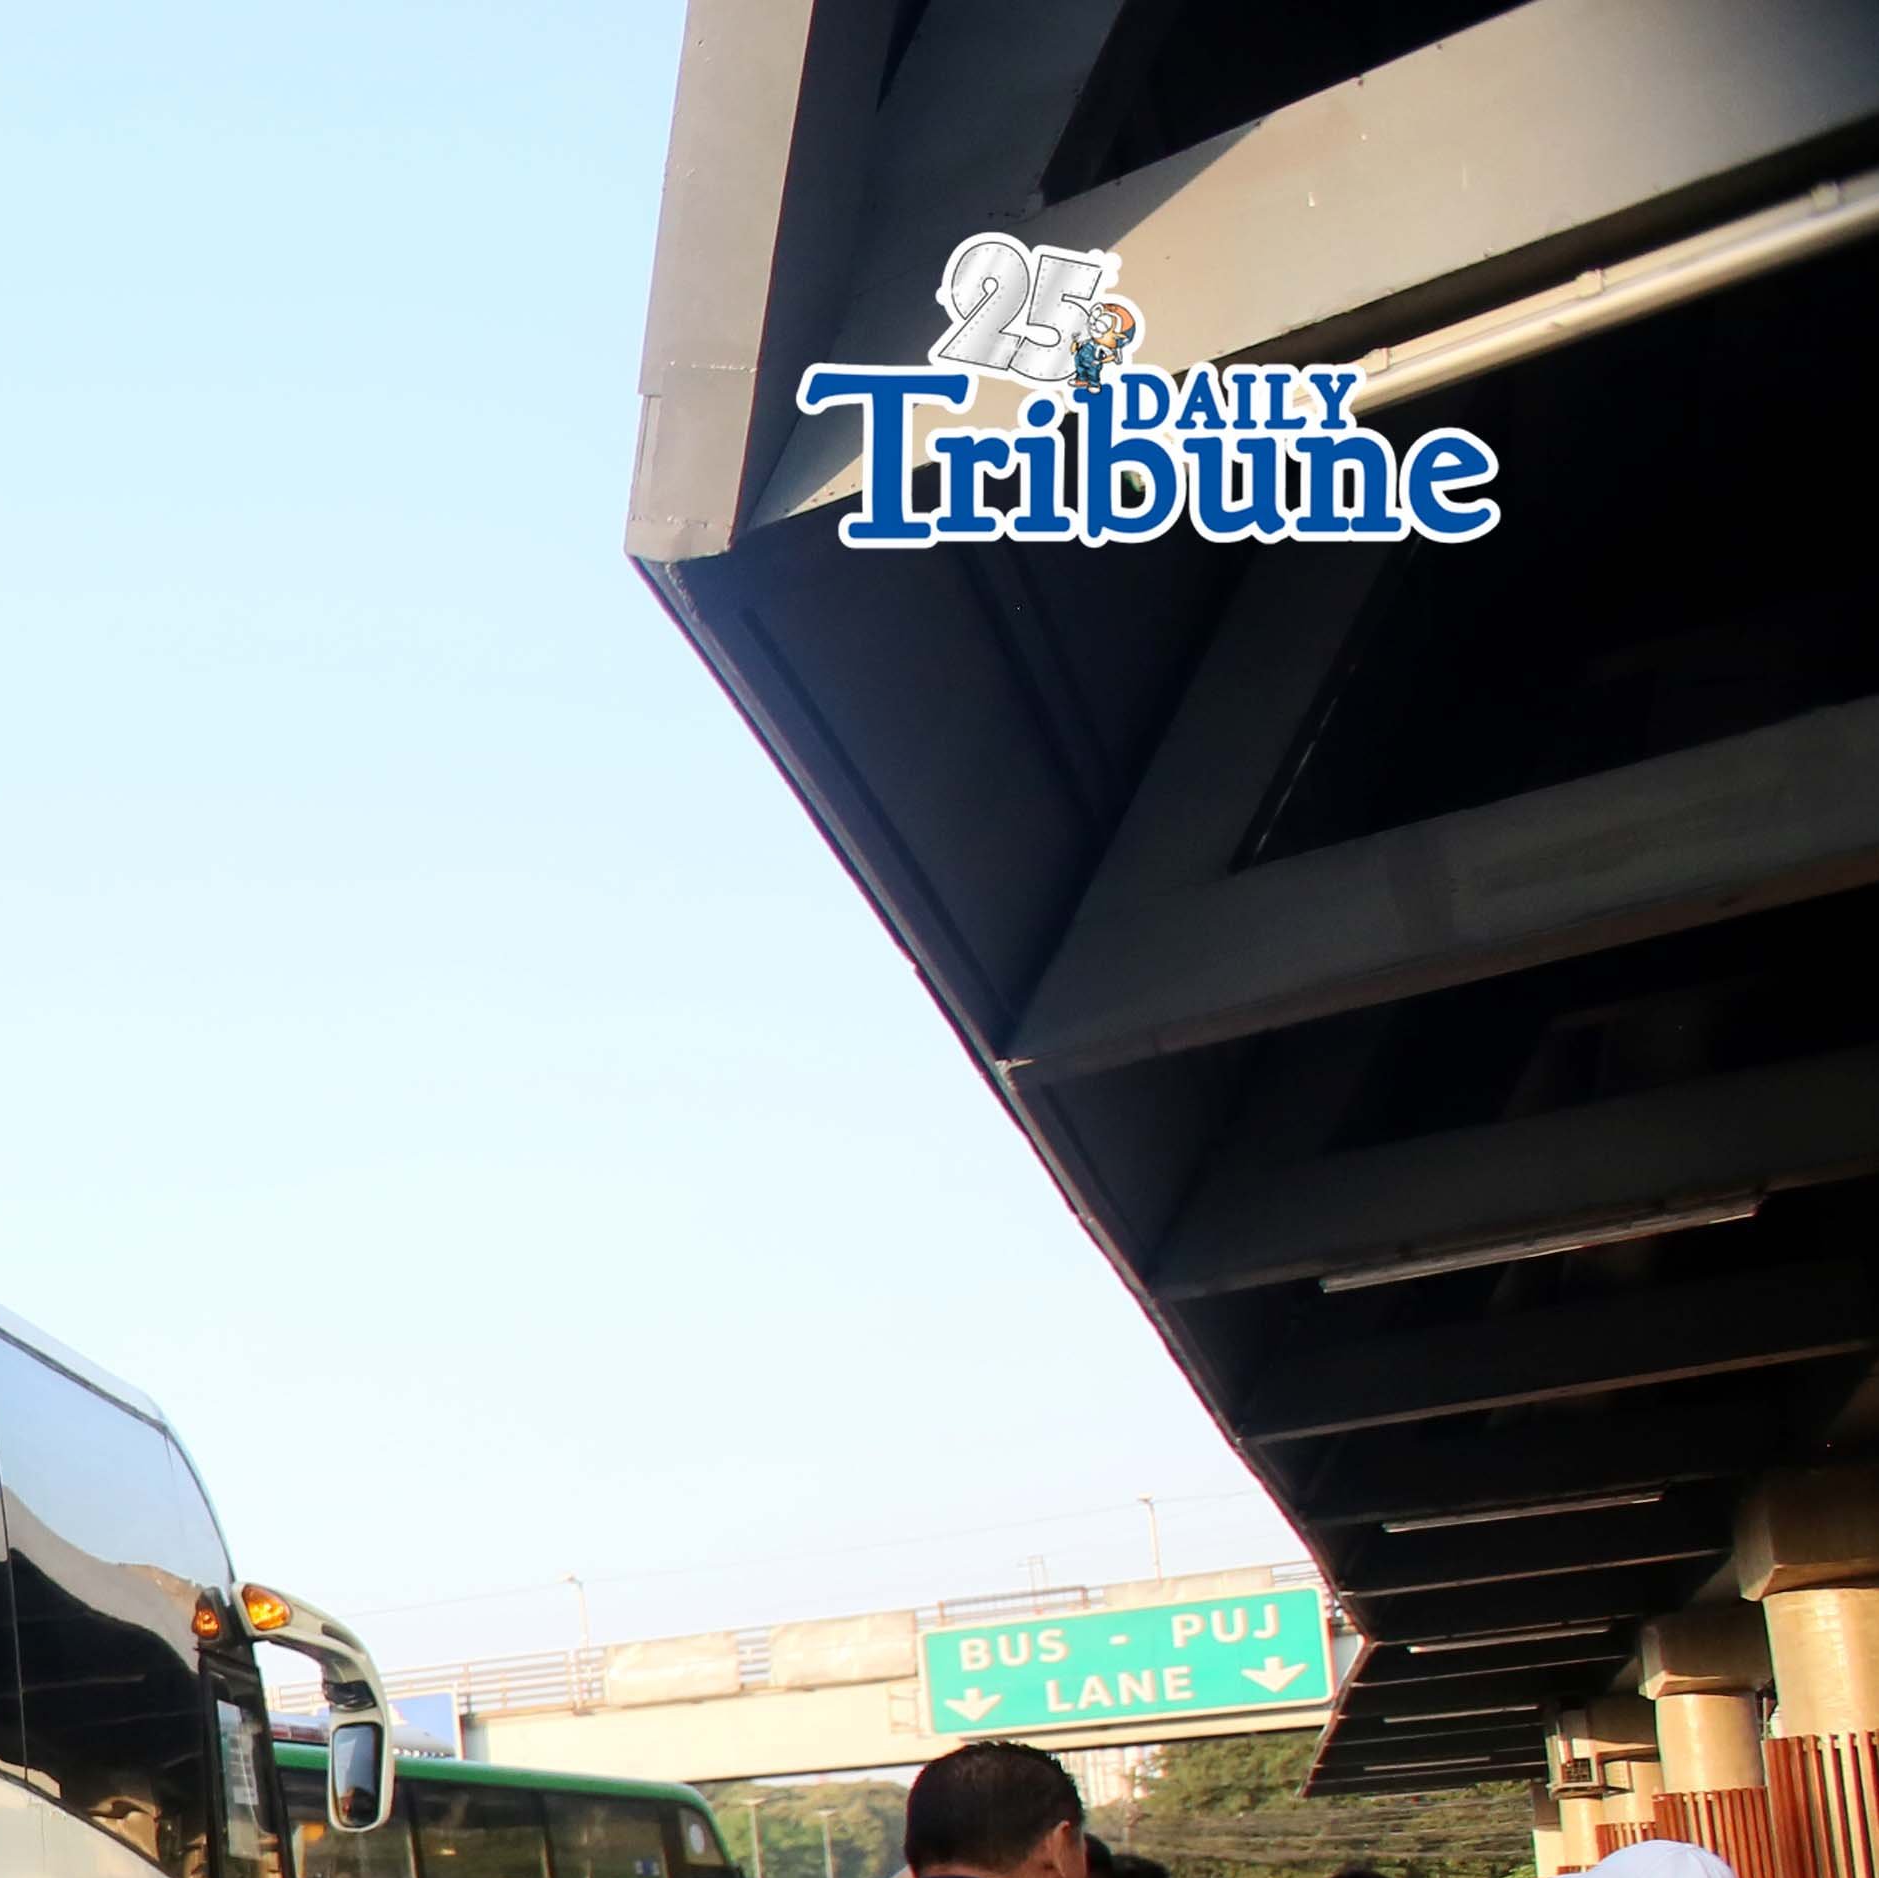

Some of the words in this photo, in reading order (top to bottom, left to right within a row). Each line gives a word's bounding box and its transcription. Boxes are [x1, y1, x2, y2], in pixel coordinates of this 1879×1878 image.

[959, 1628, 1070, 1672] BUS
[1172, 1603, 1280, 1649] PUJ
[1046, 1665, 1194, 1713] LANE
